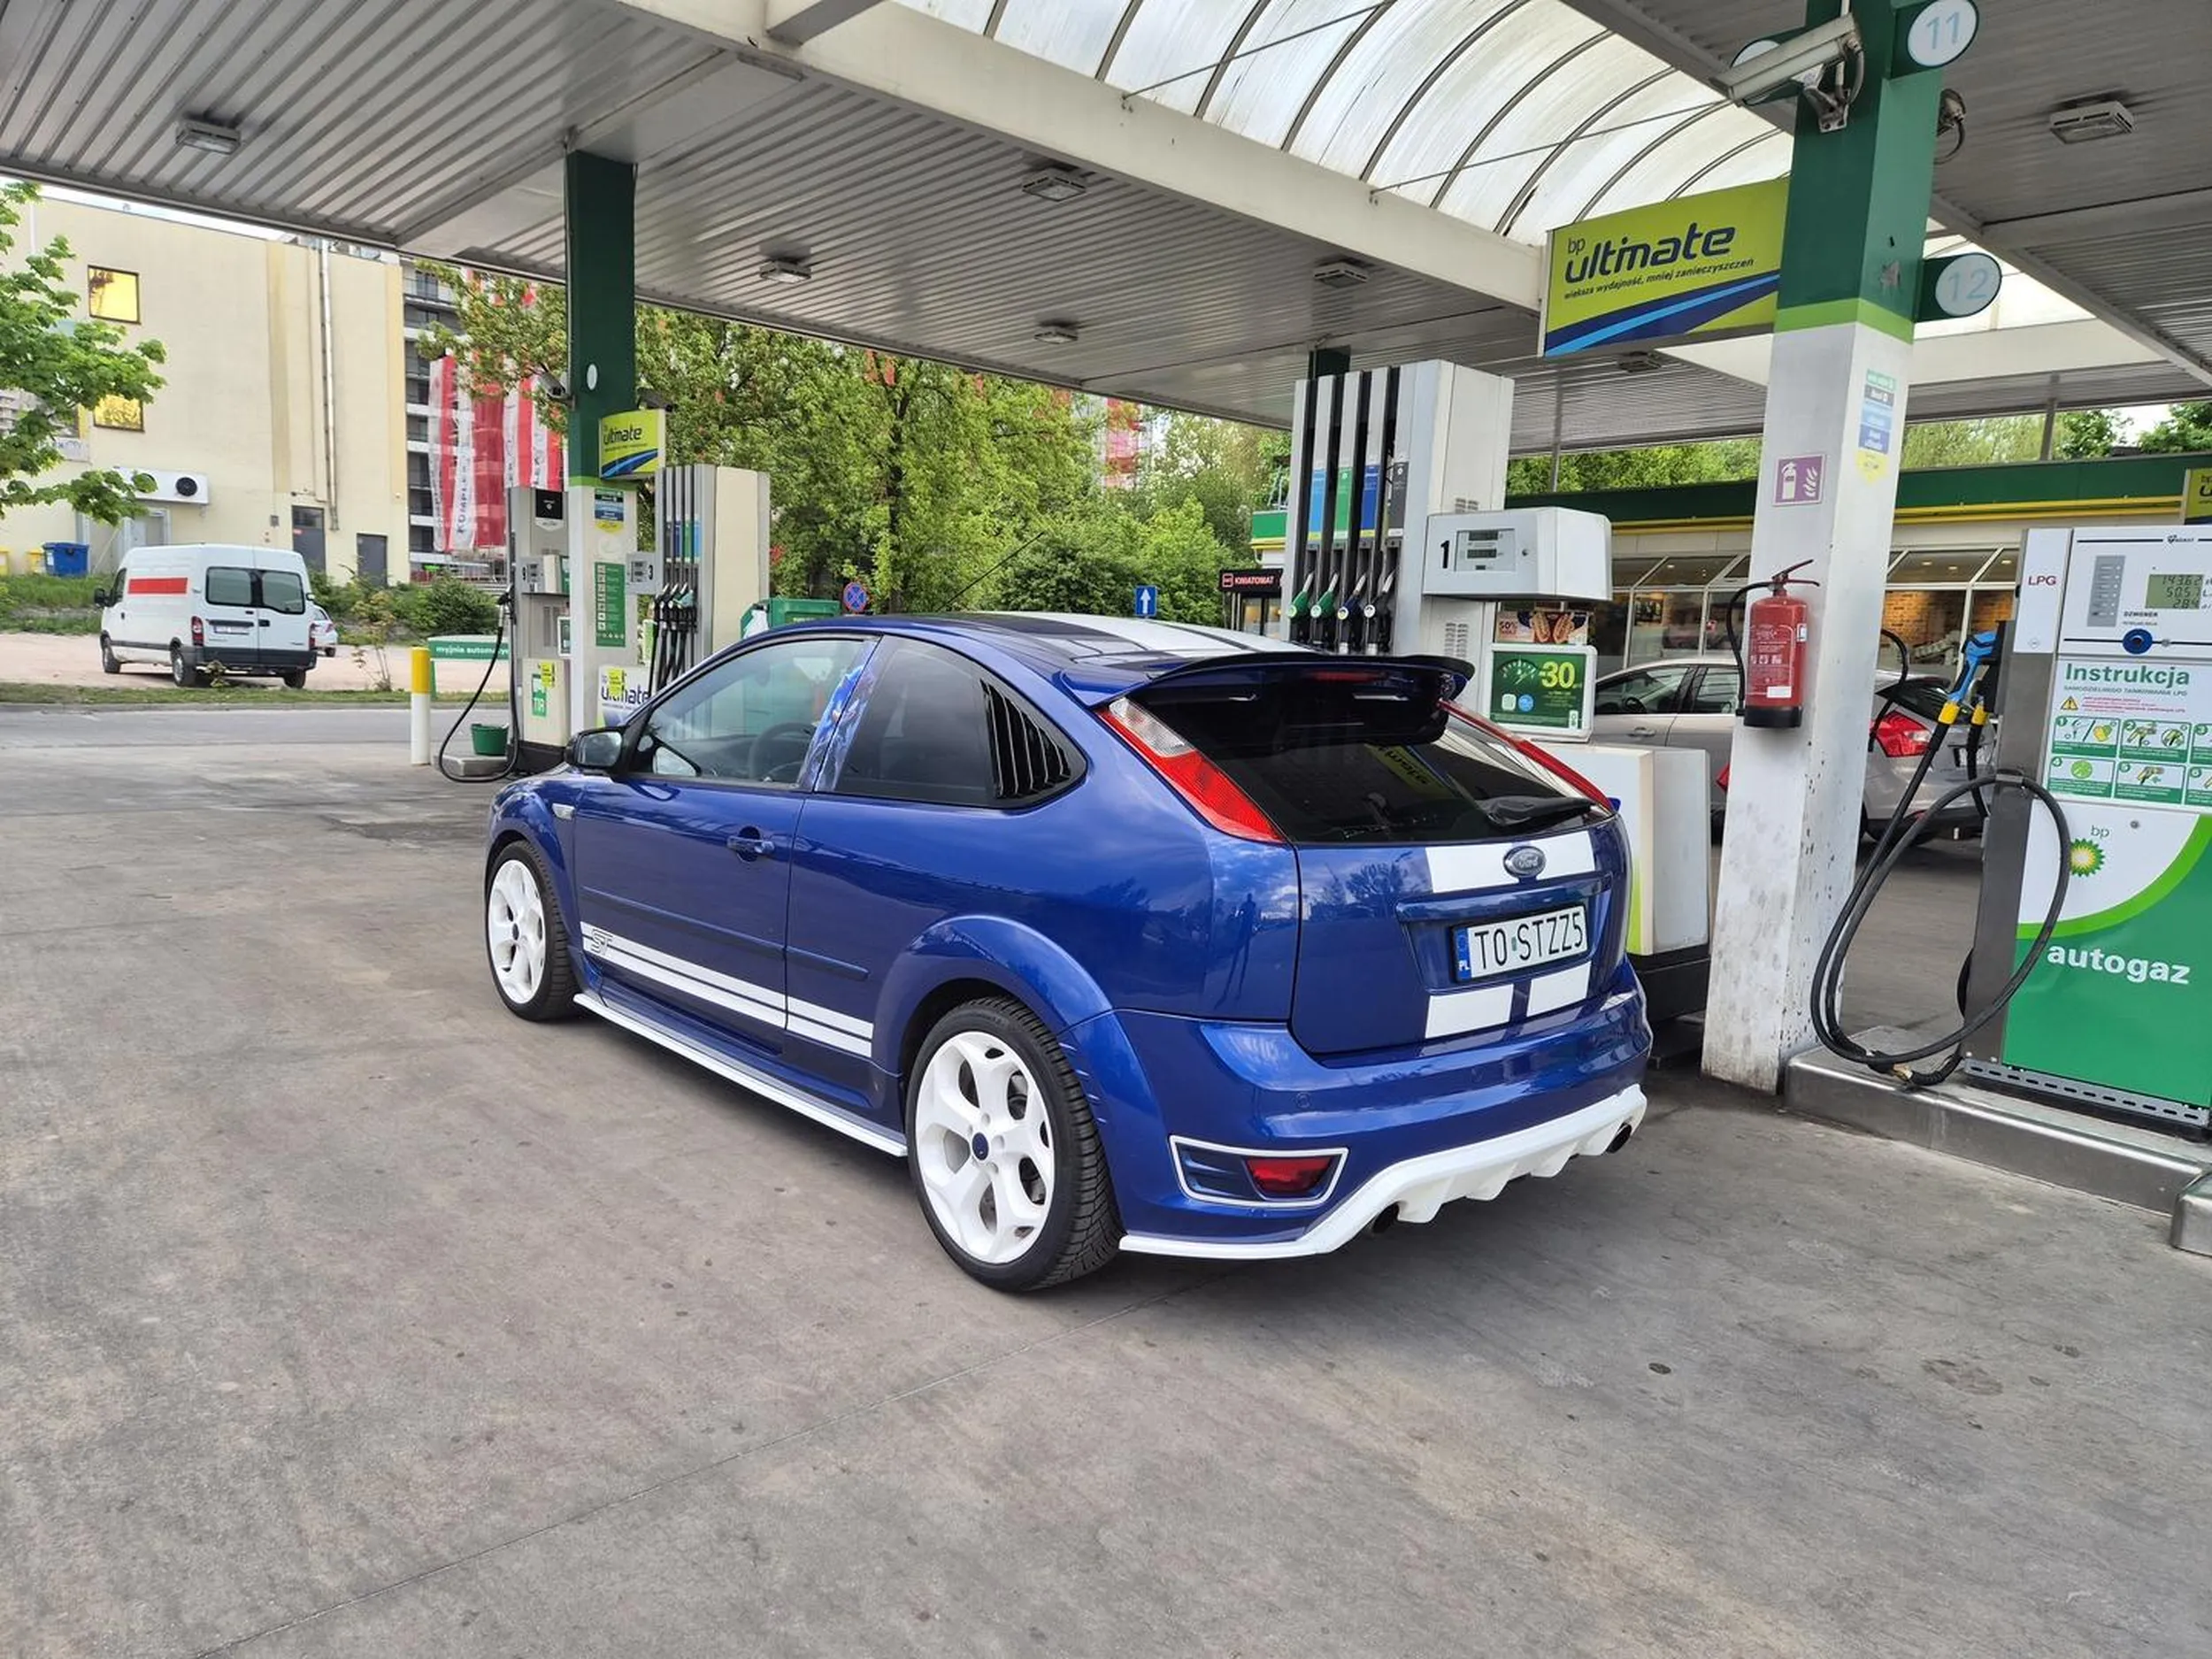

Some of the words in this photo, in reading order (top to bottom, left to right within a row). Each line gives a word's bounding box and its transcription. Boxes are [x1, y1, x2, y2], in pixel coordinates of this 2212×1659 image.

[1926, 12, 1961, 50] 11
[1564, 222, 1736, 284] ultimate
[1567, 237, 1586, 256] bp
[1646, 272, 1674, 286] mniej
[1947, 267, 1989, 303] 12
[1440, 540, 1450, 569] 1
[2028, 575, 2057, 587] LPG
[2065, 664, 2190, 689] Instrukcja
[2091, 825, 2110, 839] bp
[590, 927, 613, 956] ST
[1459, 960, 1471, 972] PL
[2047, 944, 2191, 985] autogaz
